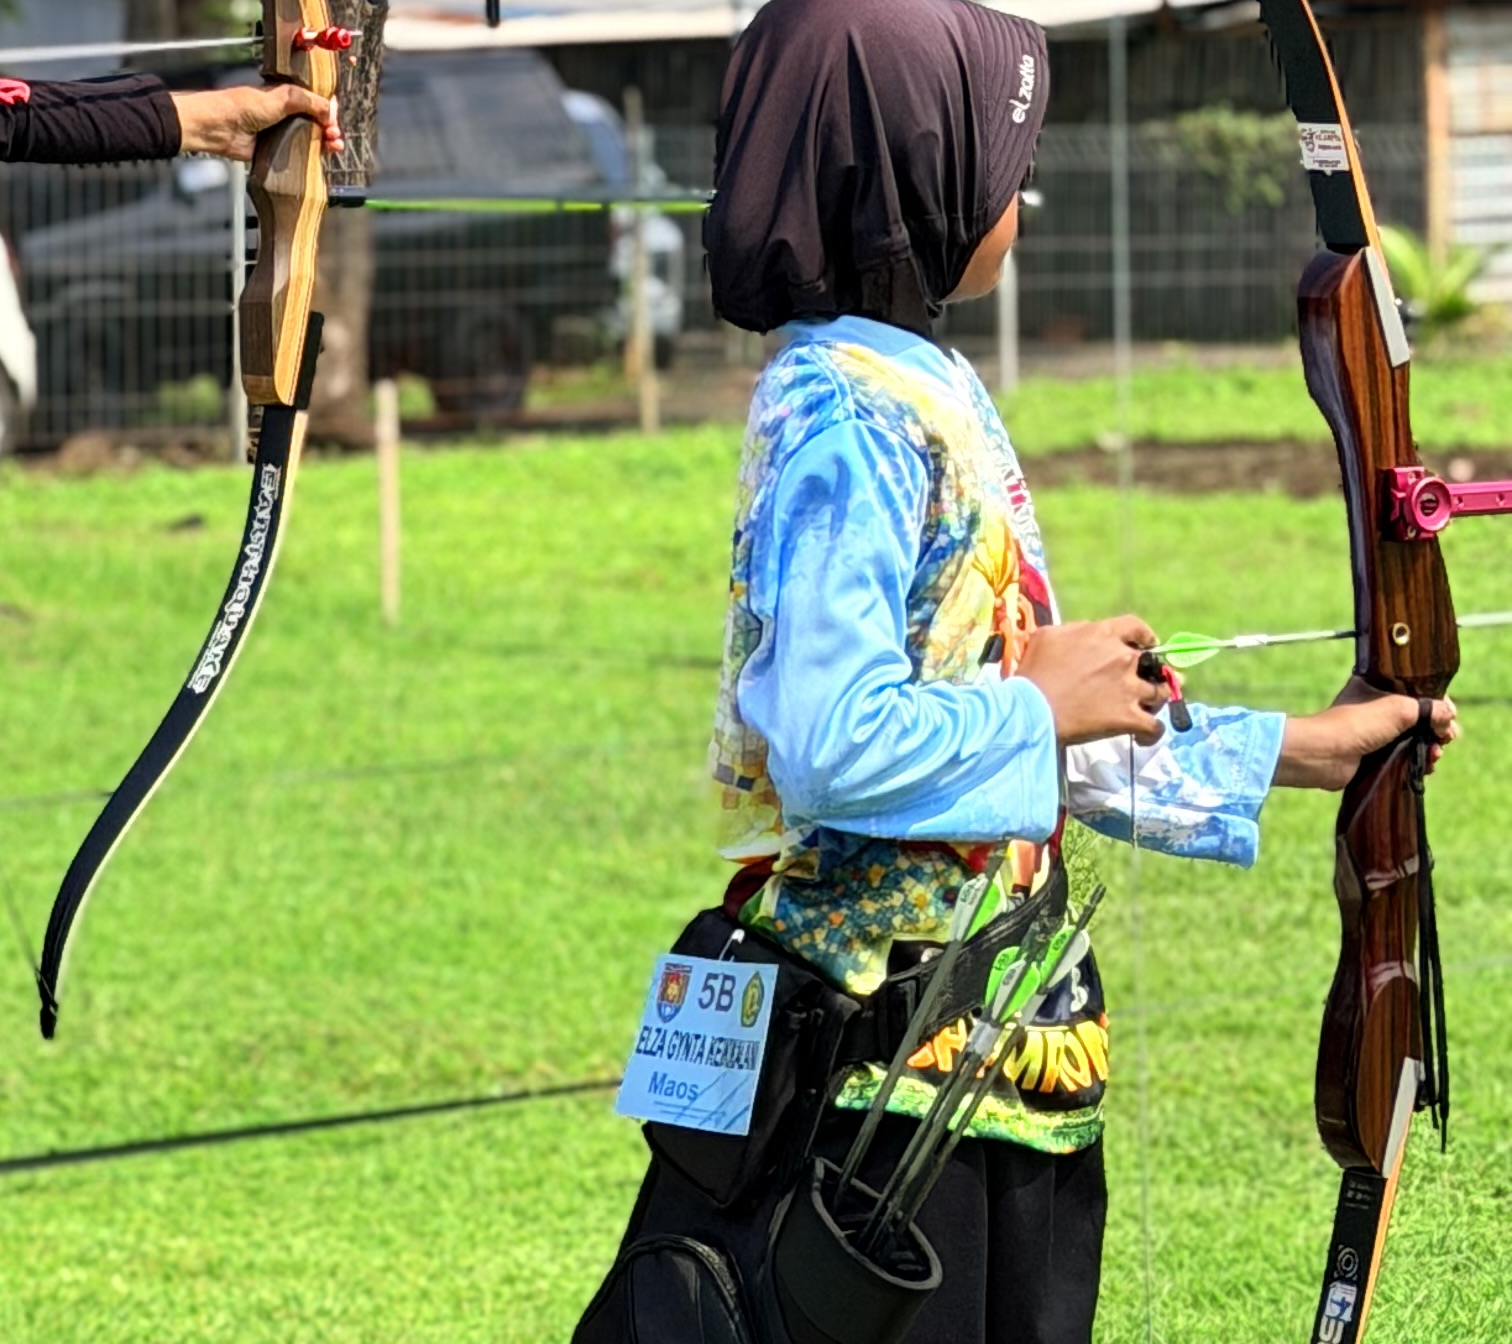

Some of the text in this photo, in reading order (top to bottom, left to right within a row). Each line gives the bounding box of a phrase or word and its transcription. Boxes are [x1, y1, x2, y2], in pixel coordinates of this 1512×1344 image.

[697, 972, 737, 1013] 5B
[635, 1025, 667, 1059] ELZA
[667, 1029, 707, 1065] GYNTA
[647, 1071, 700, 1101] Maos
